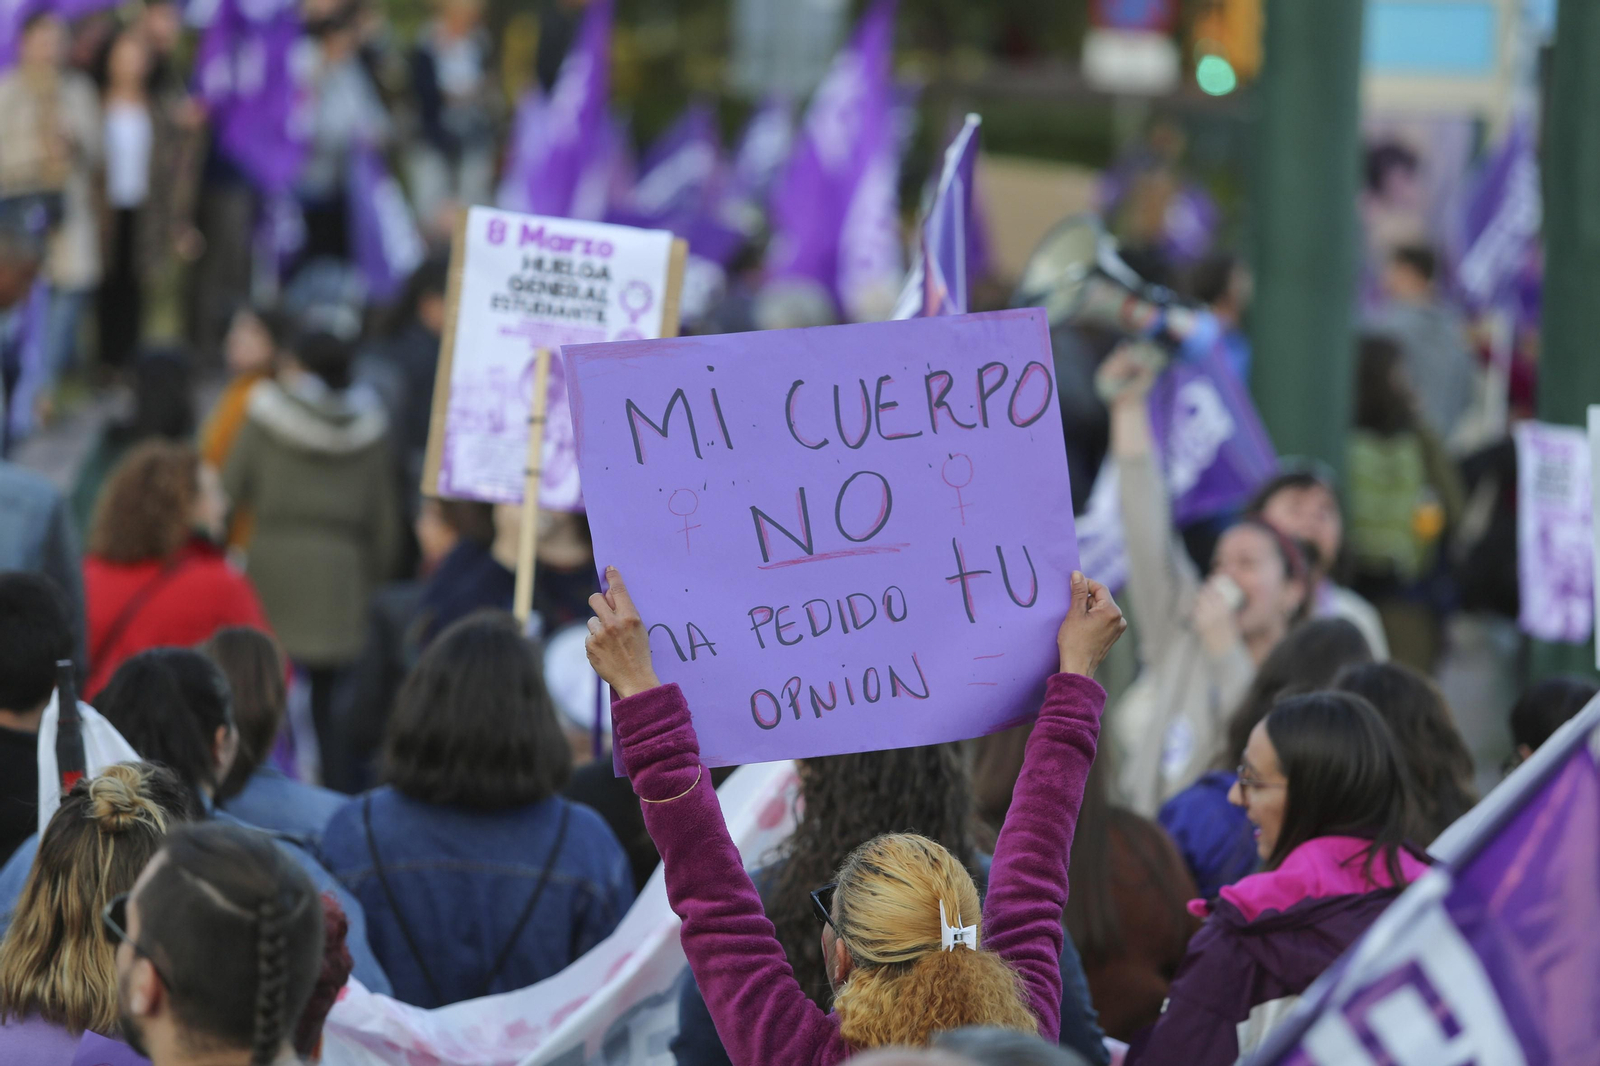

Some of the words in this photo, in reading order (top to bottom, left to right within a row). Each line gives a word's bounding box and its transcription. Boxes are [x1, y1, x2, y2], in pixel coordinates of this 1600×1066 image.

[487, 217, 507, 246] 8
[519, 222, 614, 258] Marzo
[509, 275, 611, 305] GENERAL
[521, 254, 612, 283] HUELGA
[785, 361, 1053, 449] CUERPO
[750, 470, 893, 562] NO
[748, 586, 907, 648] PEDIDO
